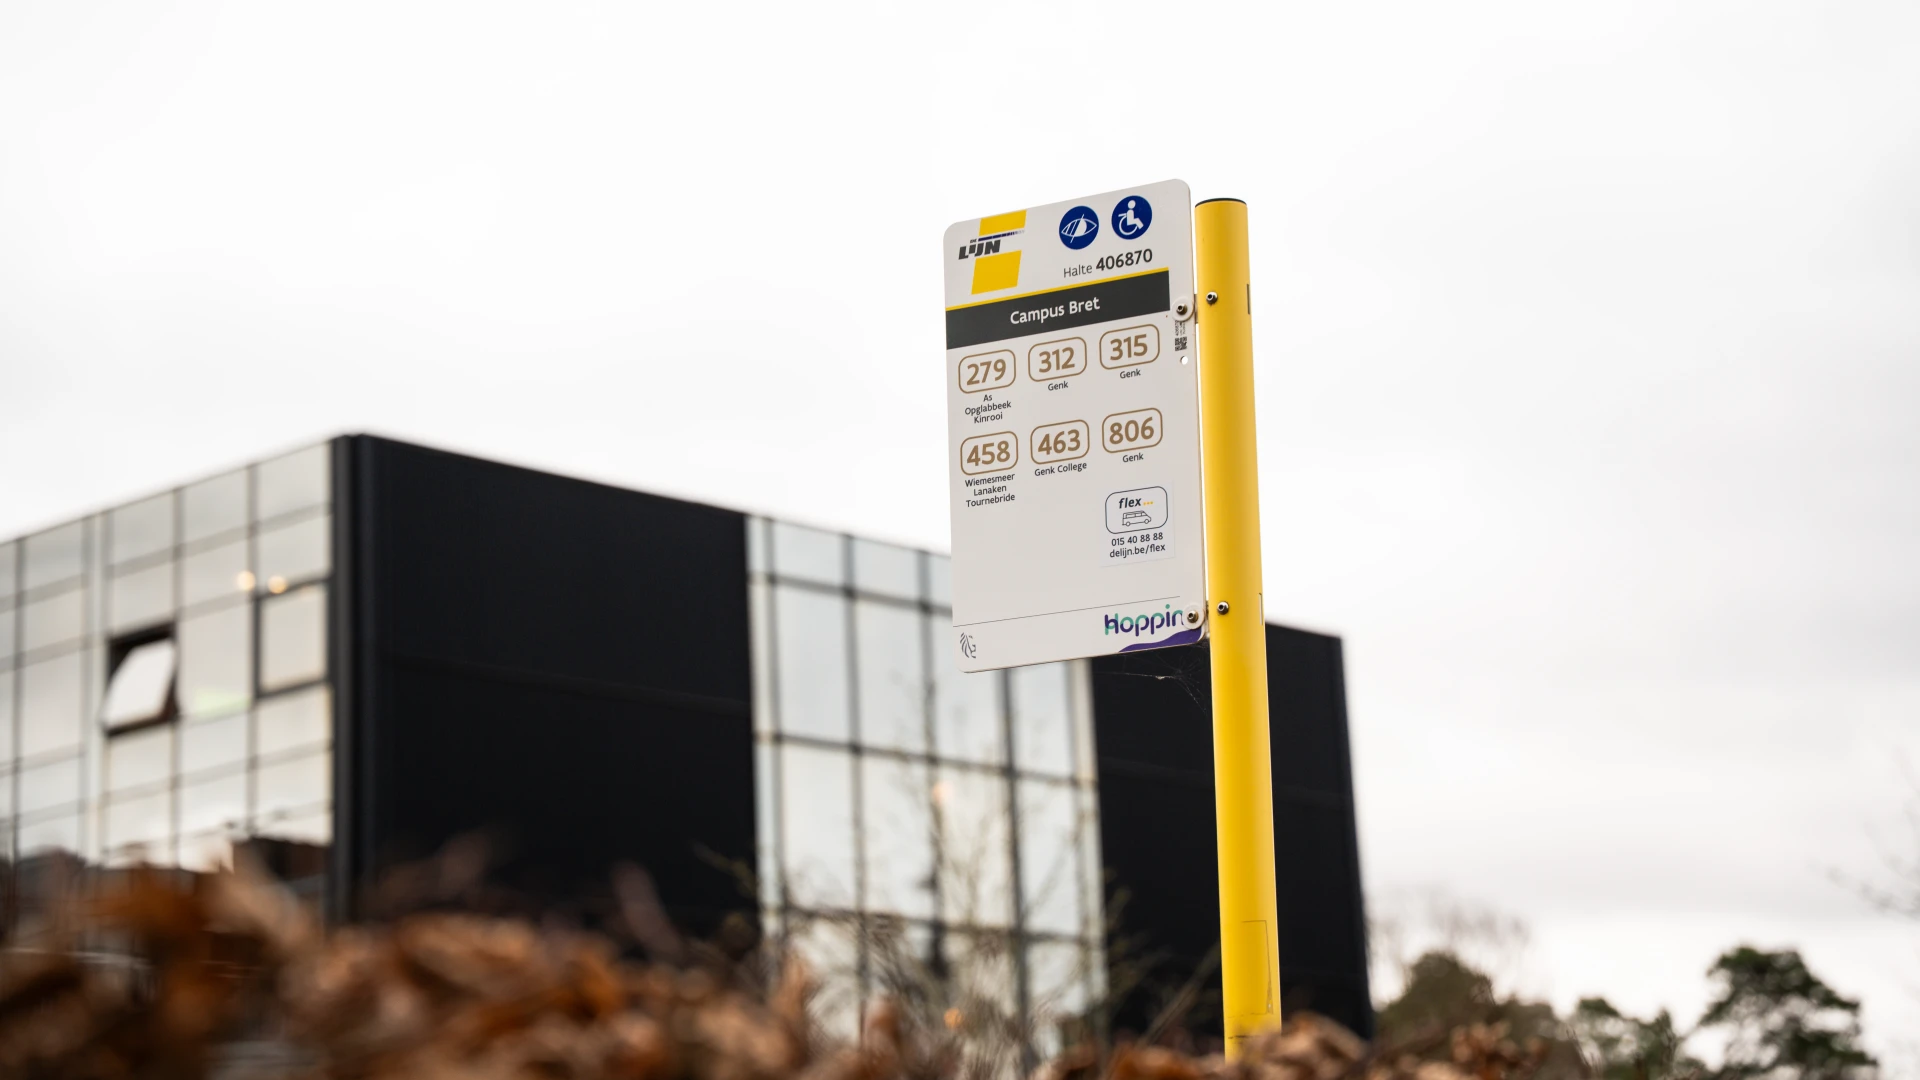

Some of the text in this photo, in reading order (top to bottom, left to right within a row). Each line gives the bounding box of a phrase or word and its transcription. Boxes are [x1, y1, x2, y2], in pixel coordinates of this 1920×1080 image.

[1063, 248, 1153, 279] Halte 406870
[1010, 296, 1100, 325] Campus Bret
[1109, 333, 1148, 361] 315
[1038, 346, 1075, 373] 312
[966, 358, 1007, 386] 279
[1119, 368, 1141, 379] Genk
[1047, 380, 1069, 391] Genk
[983, 394, 993, 402] As
[964, 400, 1012, 416] Opglabbeek
[973, 411, 1003, 424] Kinrooi
[1109, 416, 1155, 445] 806
[1037, 429, 1081, 456] 463
[966, 440, 1011, 467] 458
[1122, 452, 1144, 463] Genk
[1034, 461, 1087, 476] Genk College
[965, 472, 1016, 487] Wiemesmeer
[973, 484, 1007, 496] Lanaken
[966, 493, 1016, 508] Tournebride
[1111, 532, 1163, 547] 015 40 88 88
[1109, 543, 1166, 559] delijn.be/flex
